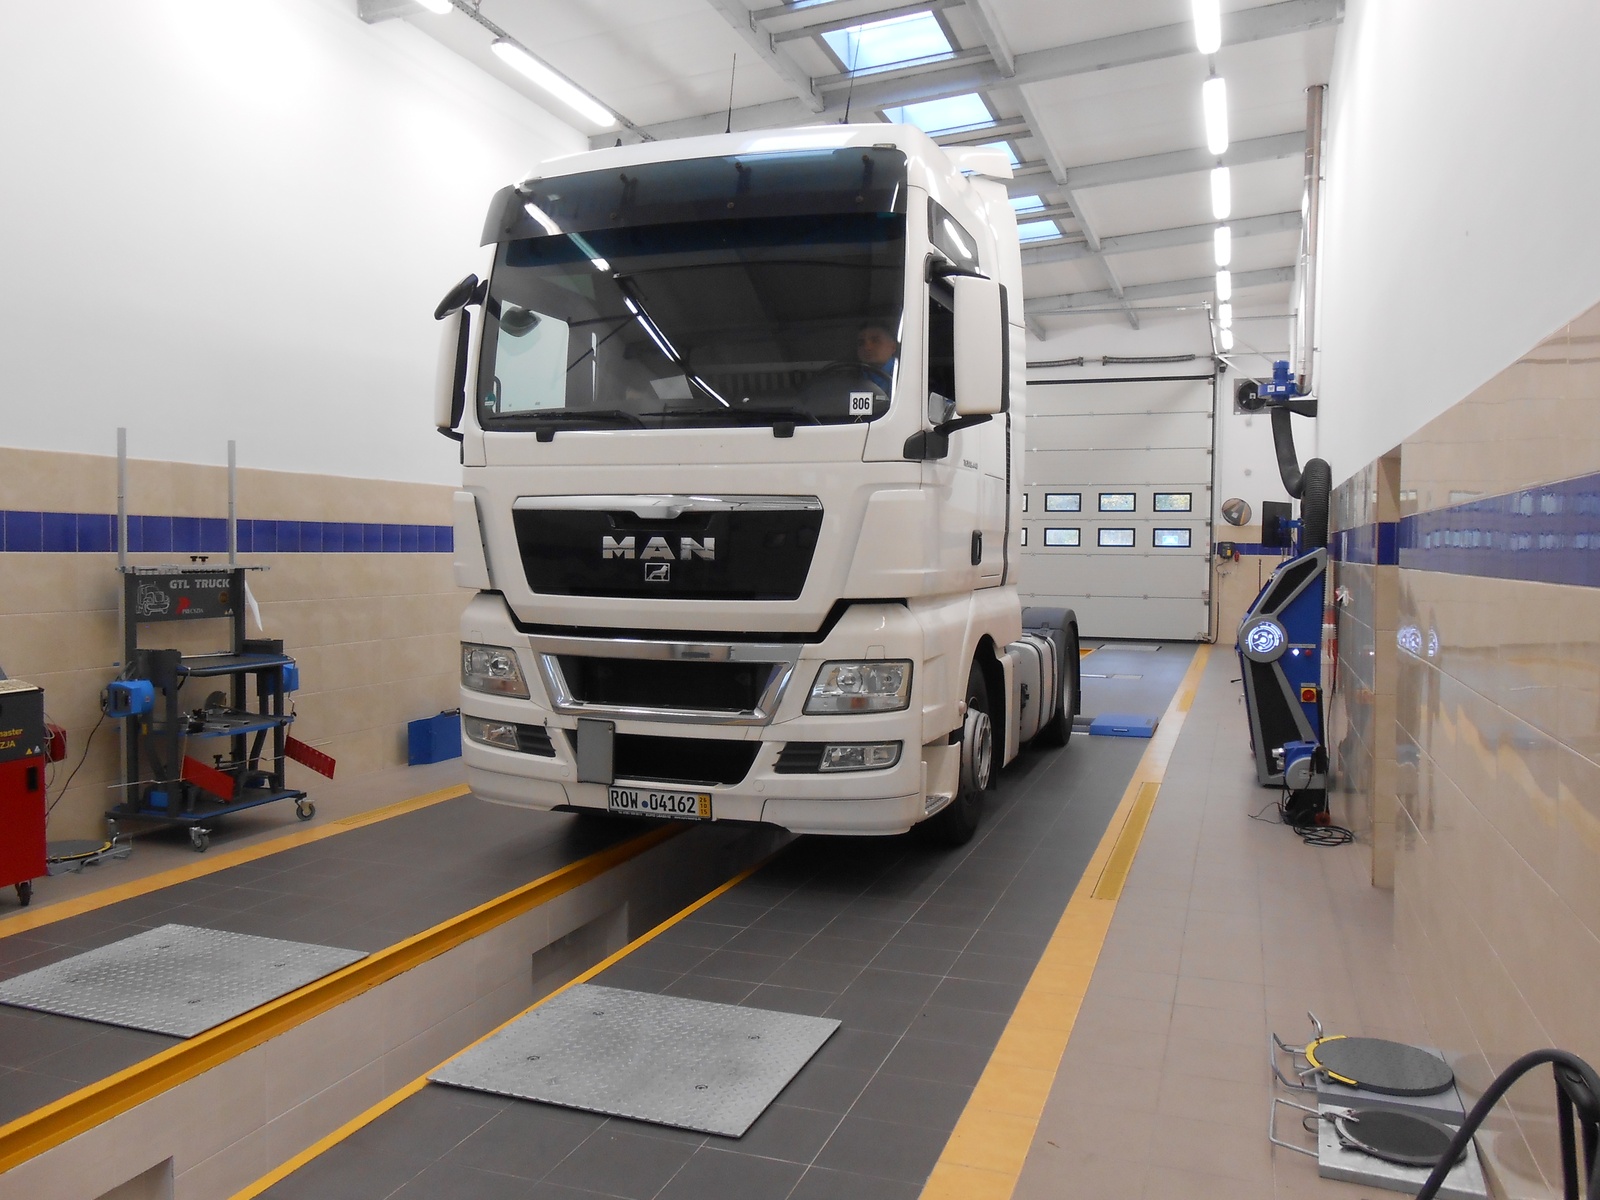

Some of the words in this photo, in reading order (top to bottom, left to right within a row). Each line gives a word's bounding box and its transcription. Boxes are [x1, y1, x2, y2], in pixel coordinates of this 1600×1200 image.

[852, 397, 870, 410] 806
[602, 536, 716, 561] MAN
[169, 579, 190, 589] GTL
[194, 578, 230, 589] TRUCK
[610, 790, 638, 809] ROW
[649, 793, 696, 814] 04162
